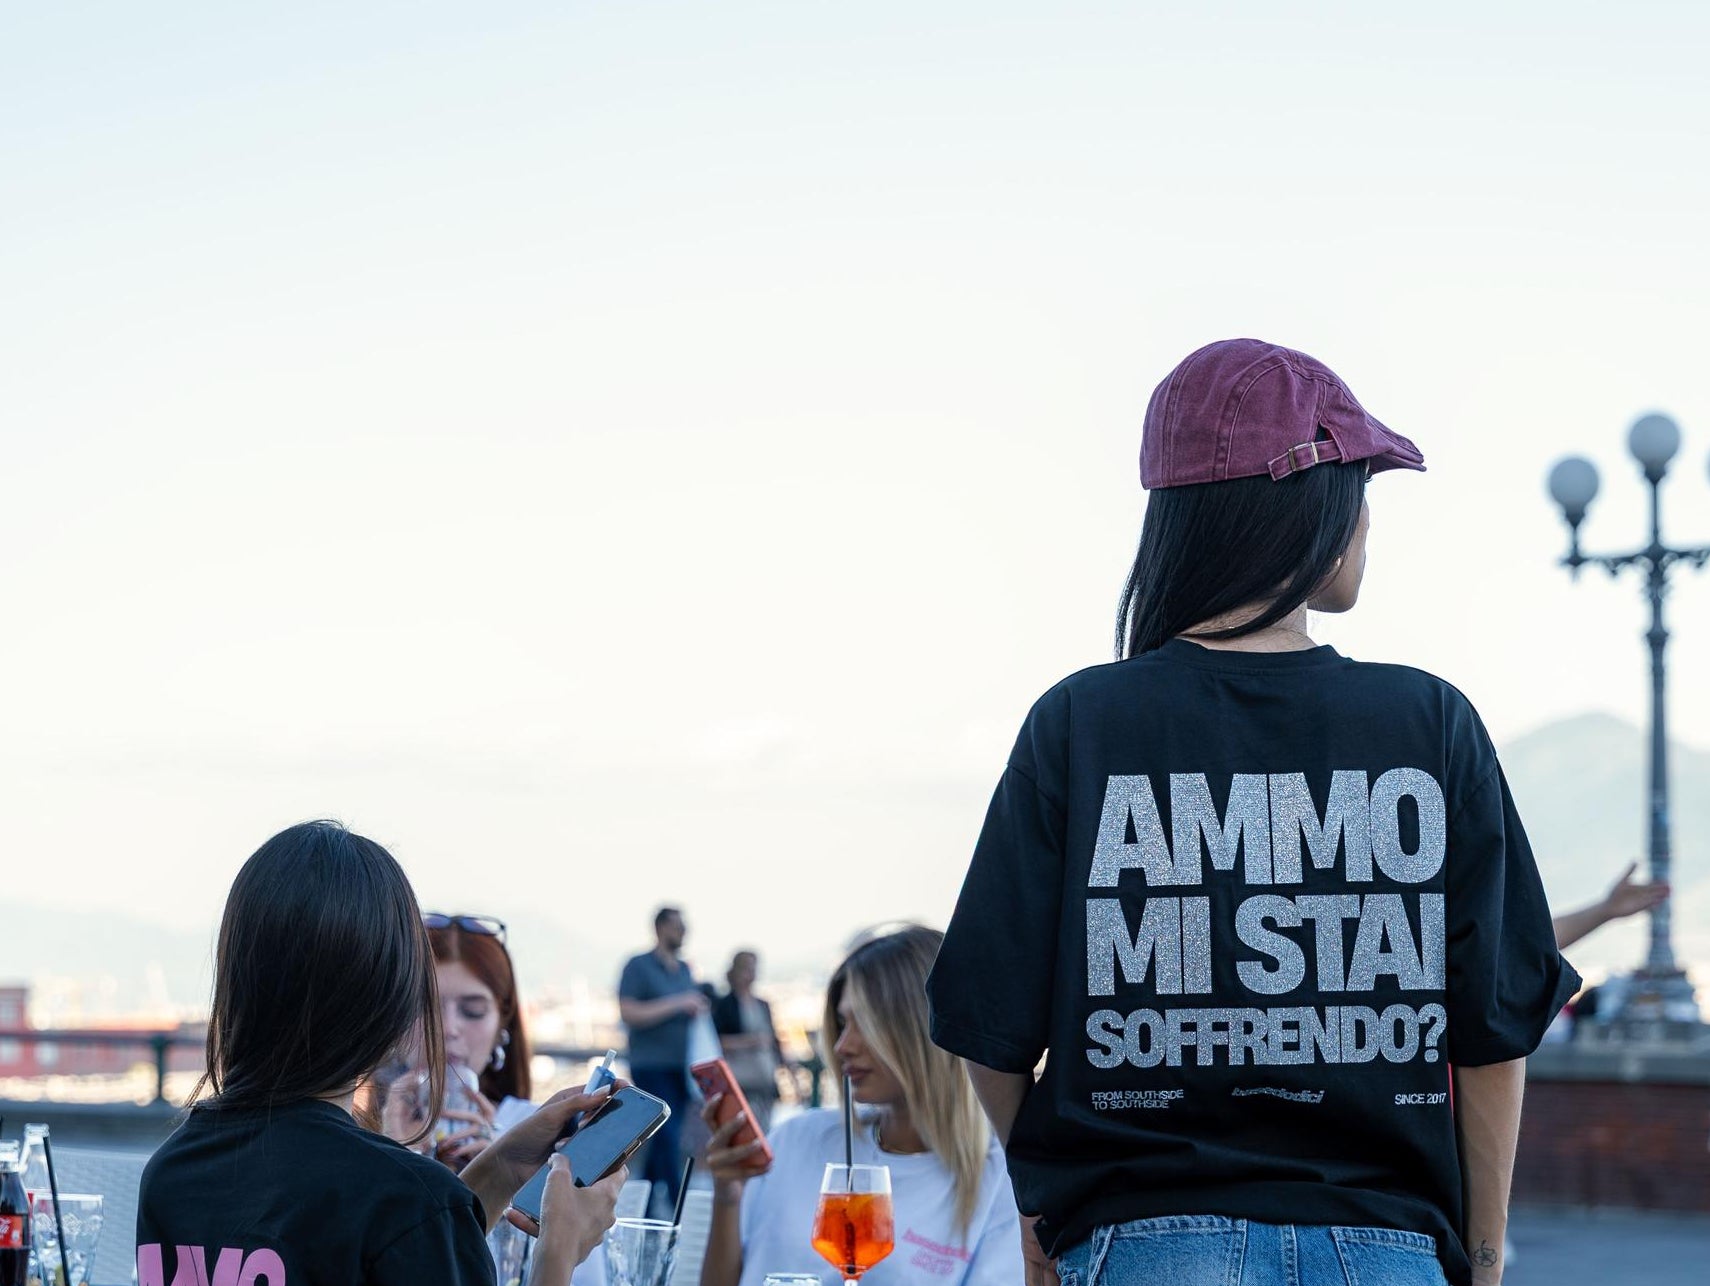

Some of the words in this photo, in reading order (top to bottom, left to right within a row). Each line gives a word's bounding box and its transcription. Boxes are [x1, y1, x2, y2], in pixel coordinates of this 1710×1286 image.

[1087, 767, 1446, 887] AMMO
[1086, 895, 1212, 996] MI
[1235, 893, 1446, 995] STAI
[1085, 1003, 1447, 1068] SOFFRENDO?
[1091, 1090, 1122, 1101] FROM
[1124, 1089, 1185, 1101] SOUTHSIDE
[1092, 1101, 1108, 1111] TO
[1110, 1099, 1170, 1110] SOUTHSIDE
[1394, 1093, 1425, 1105] SINCE
[1426, 1092, 1447, 1105] 2017
